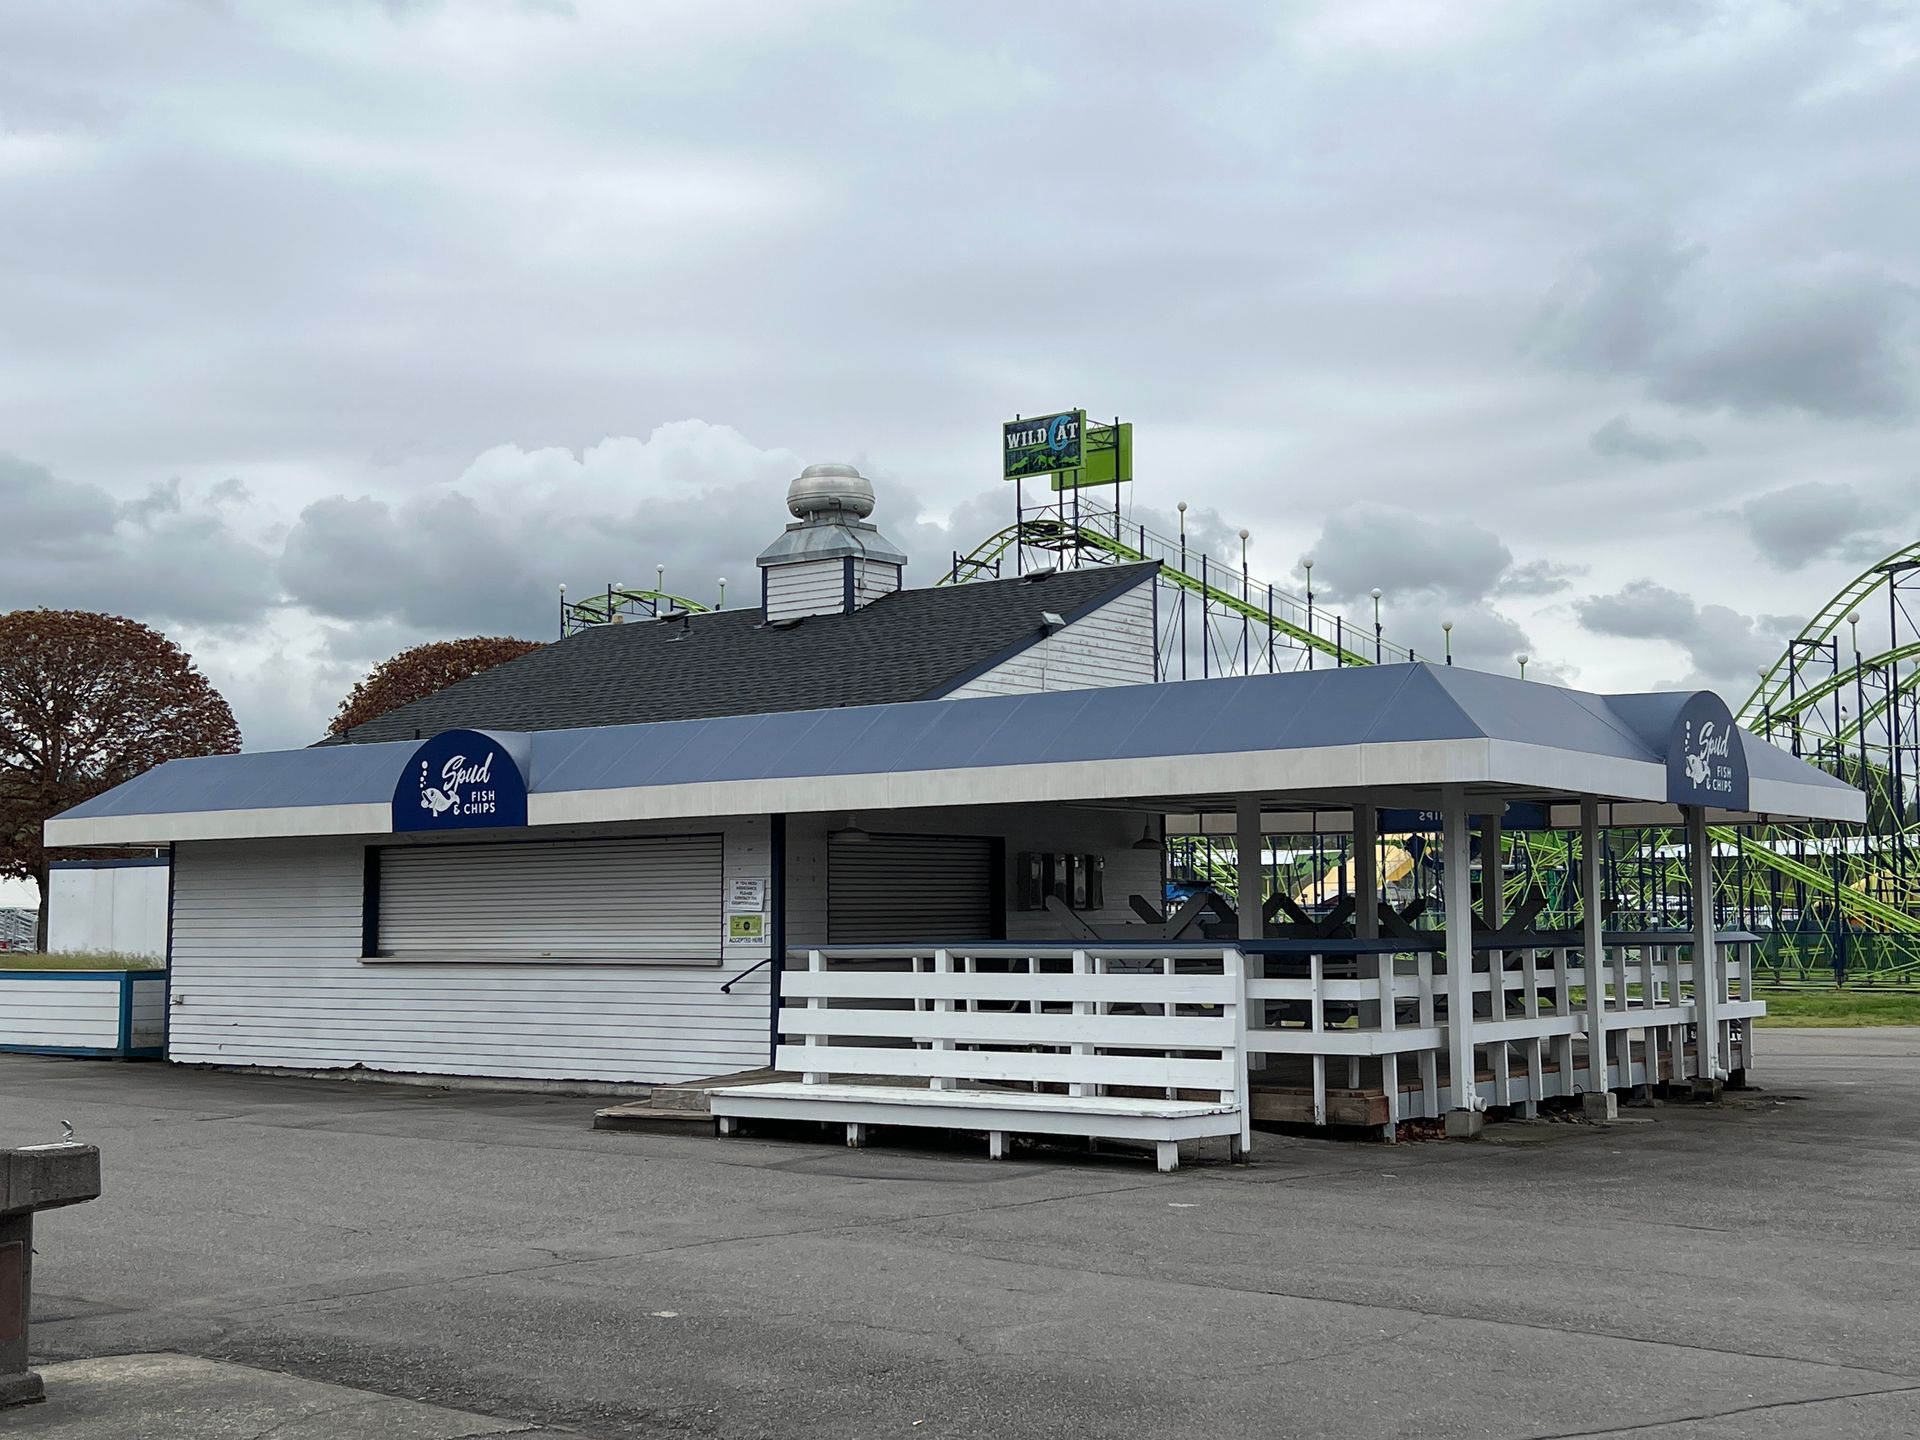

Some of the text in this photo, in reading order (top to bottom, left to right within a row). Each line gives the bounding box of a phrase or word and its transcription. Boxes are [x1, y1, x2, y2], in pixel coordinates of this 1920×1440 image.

[1699, 721, 1730, 762] Spud
[441, 752, 493, 792] Spud
[1717, 765, 1731, 778] FISH
[1712, 779, 1732, 793] CHIPS
[471, 790, 495, 802] FISH
[453, 802, 496, 815] & CHIPS
